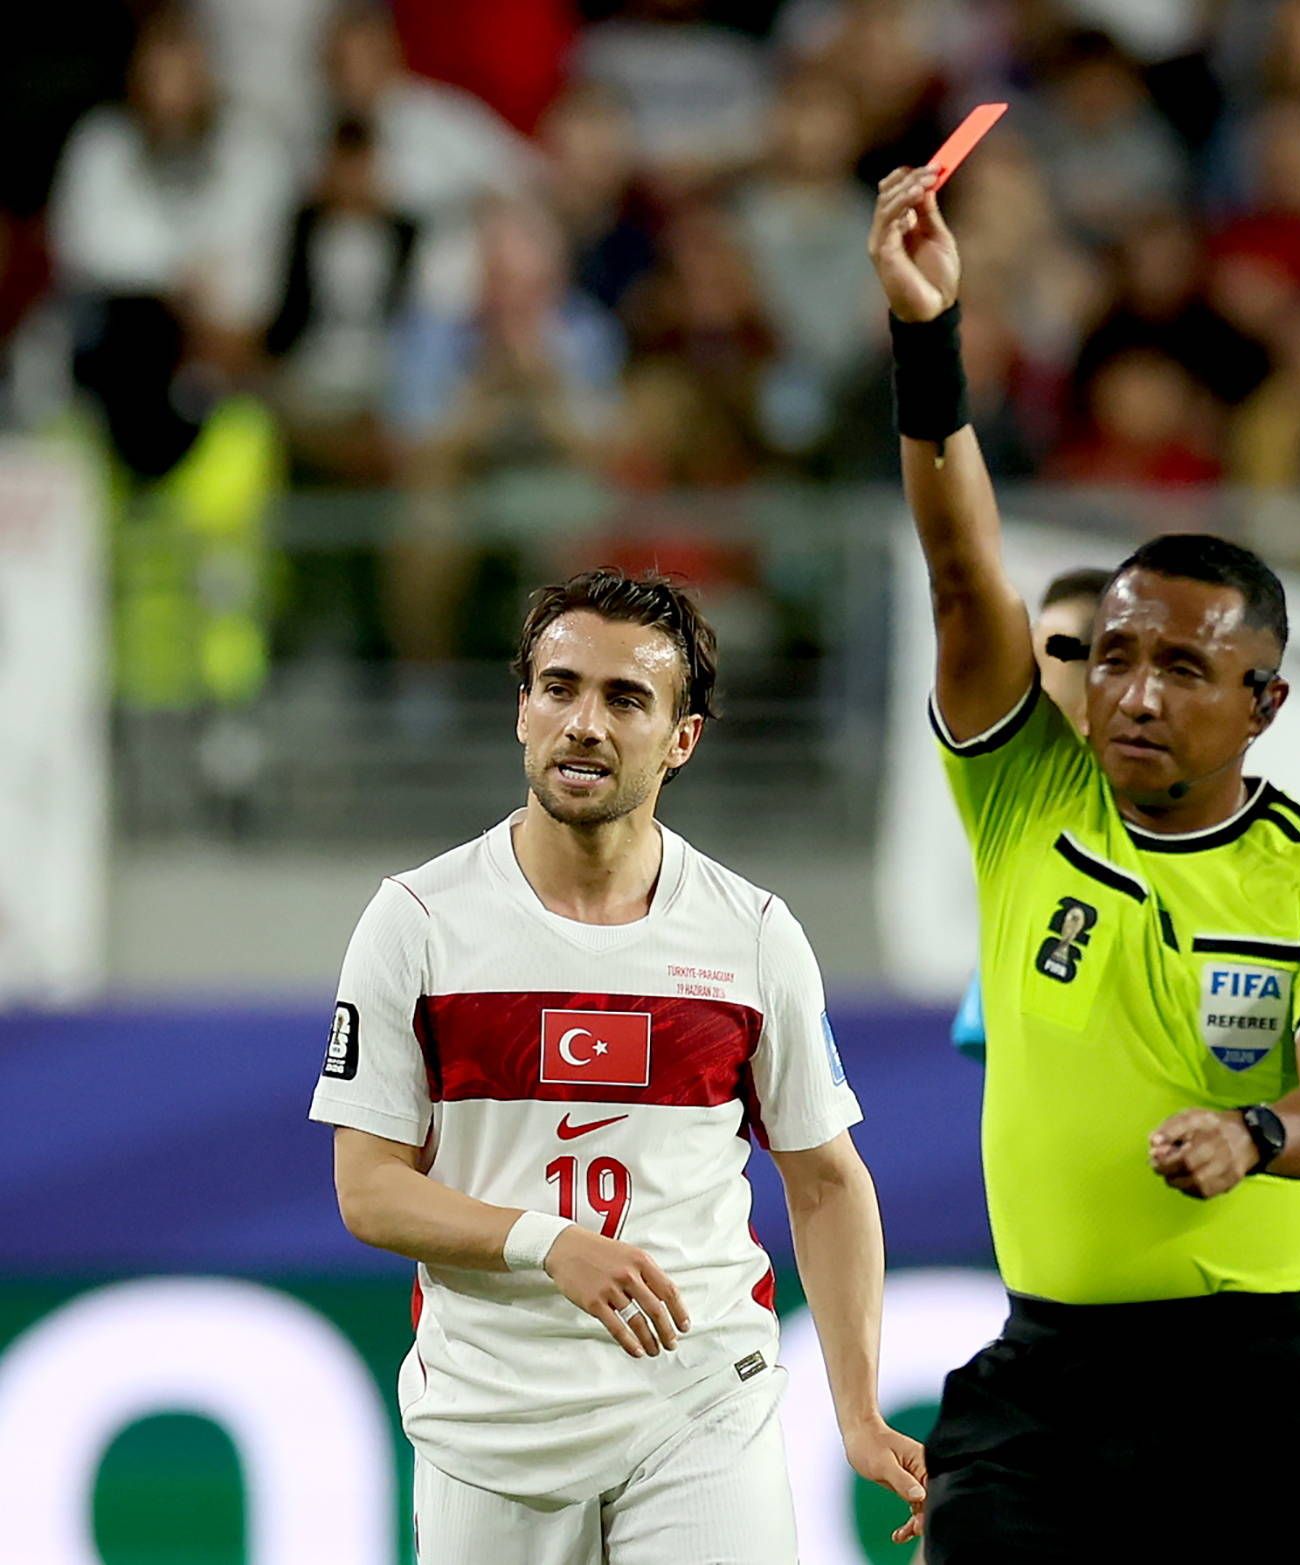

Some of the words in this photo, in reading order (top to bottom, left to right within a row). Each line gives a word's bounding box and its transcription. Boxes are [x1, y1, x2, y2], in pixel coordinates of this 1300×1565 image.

[1211, 972, 1281, 1000] FIFA
[1207, 1014, 1277, 1031] REFEREE
[546, 1156, 632, 1240] 19
